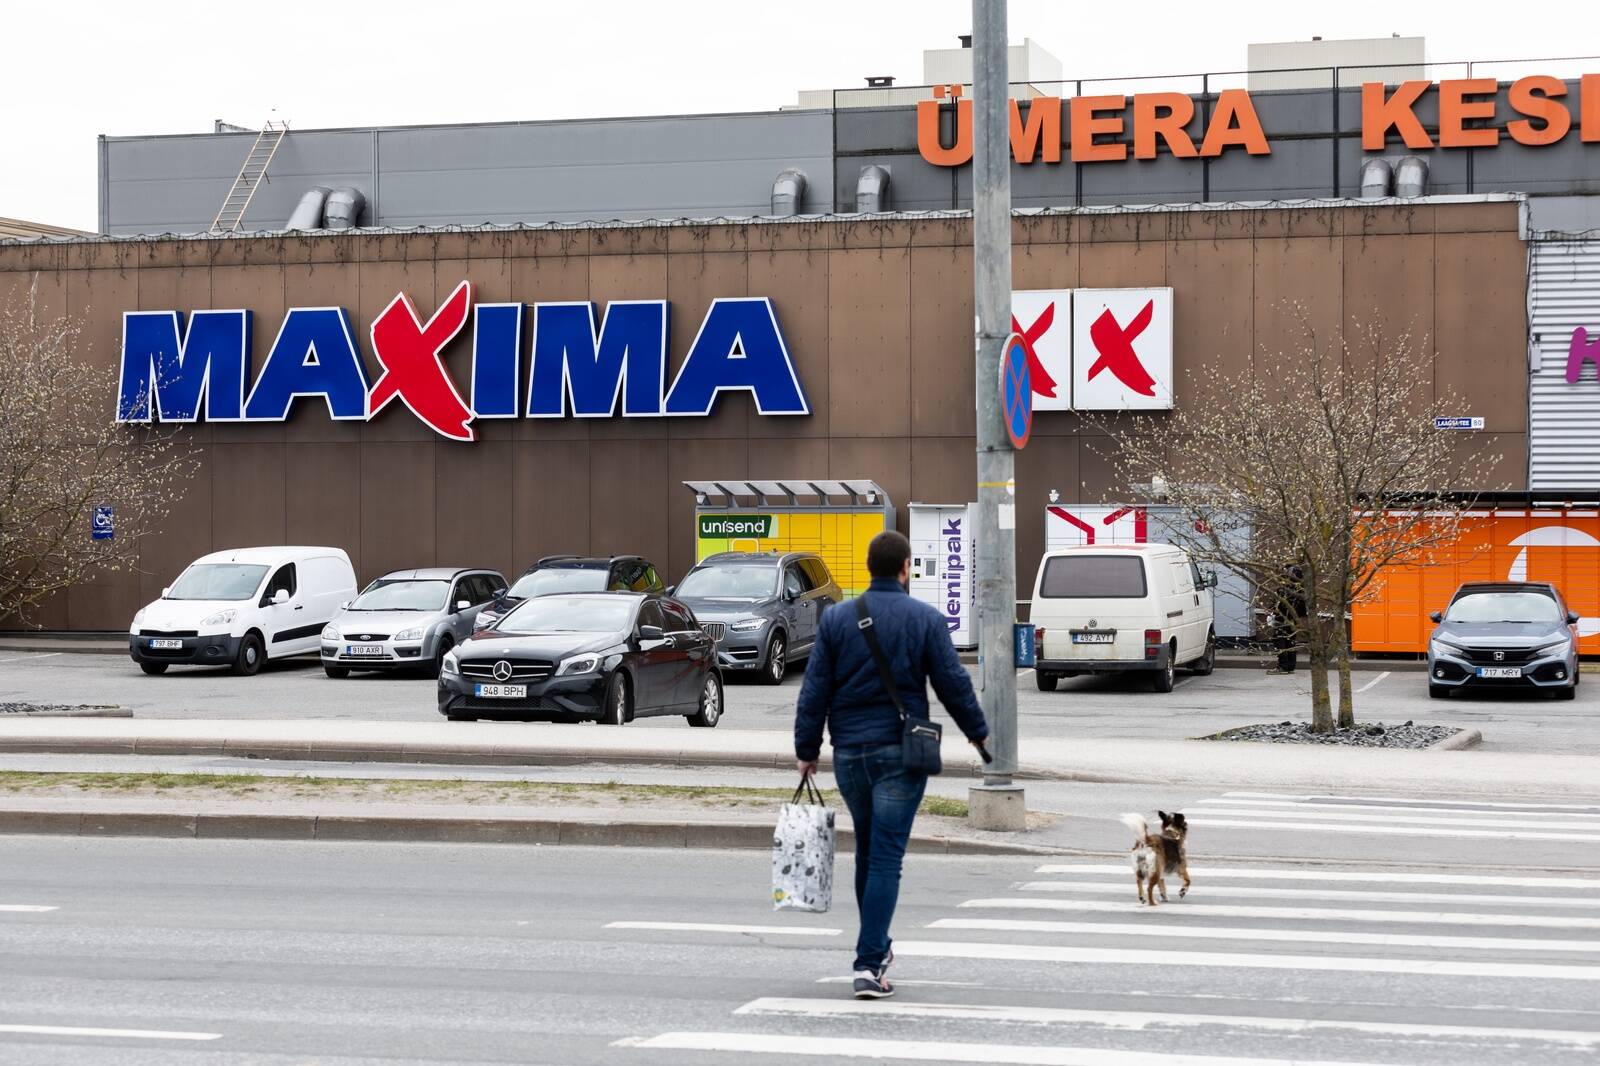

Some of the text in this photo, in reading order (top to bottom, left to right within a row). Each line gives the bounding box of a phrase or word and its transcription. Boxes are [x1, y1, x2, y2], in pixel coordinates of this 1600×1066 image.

[917, 75, 1600, 167] ÜMERA KES
[115, 279, 810, 442] MAXIMA
[1437, 419, 1460, 427] LAAGA
[1460, 419, 1471, 427] TEE
[702, 520, 765, 533] unisend
[942, 518, 965, 634] Venipak
[1080, 634, 1110, 642] 492 AYT
[352, 645, 381, 653] 910 AXR
[1484, 668, 1519, 677] 717 MRY
[483, 686, 525, 696] 948 BPH
